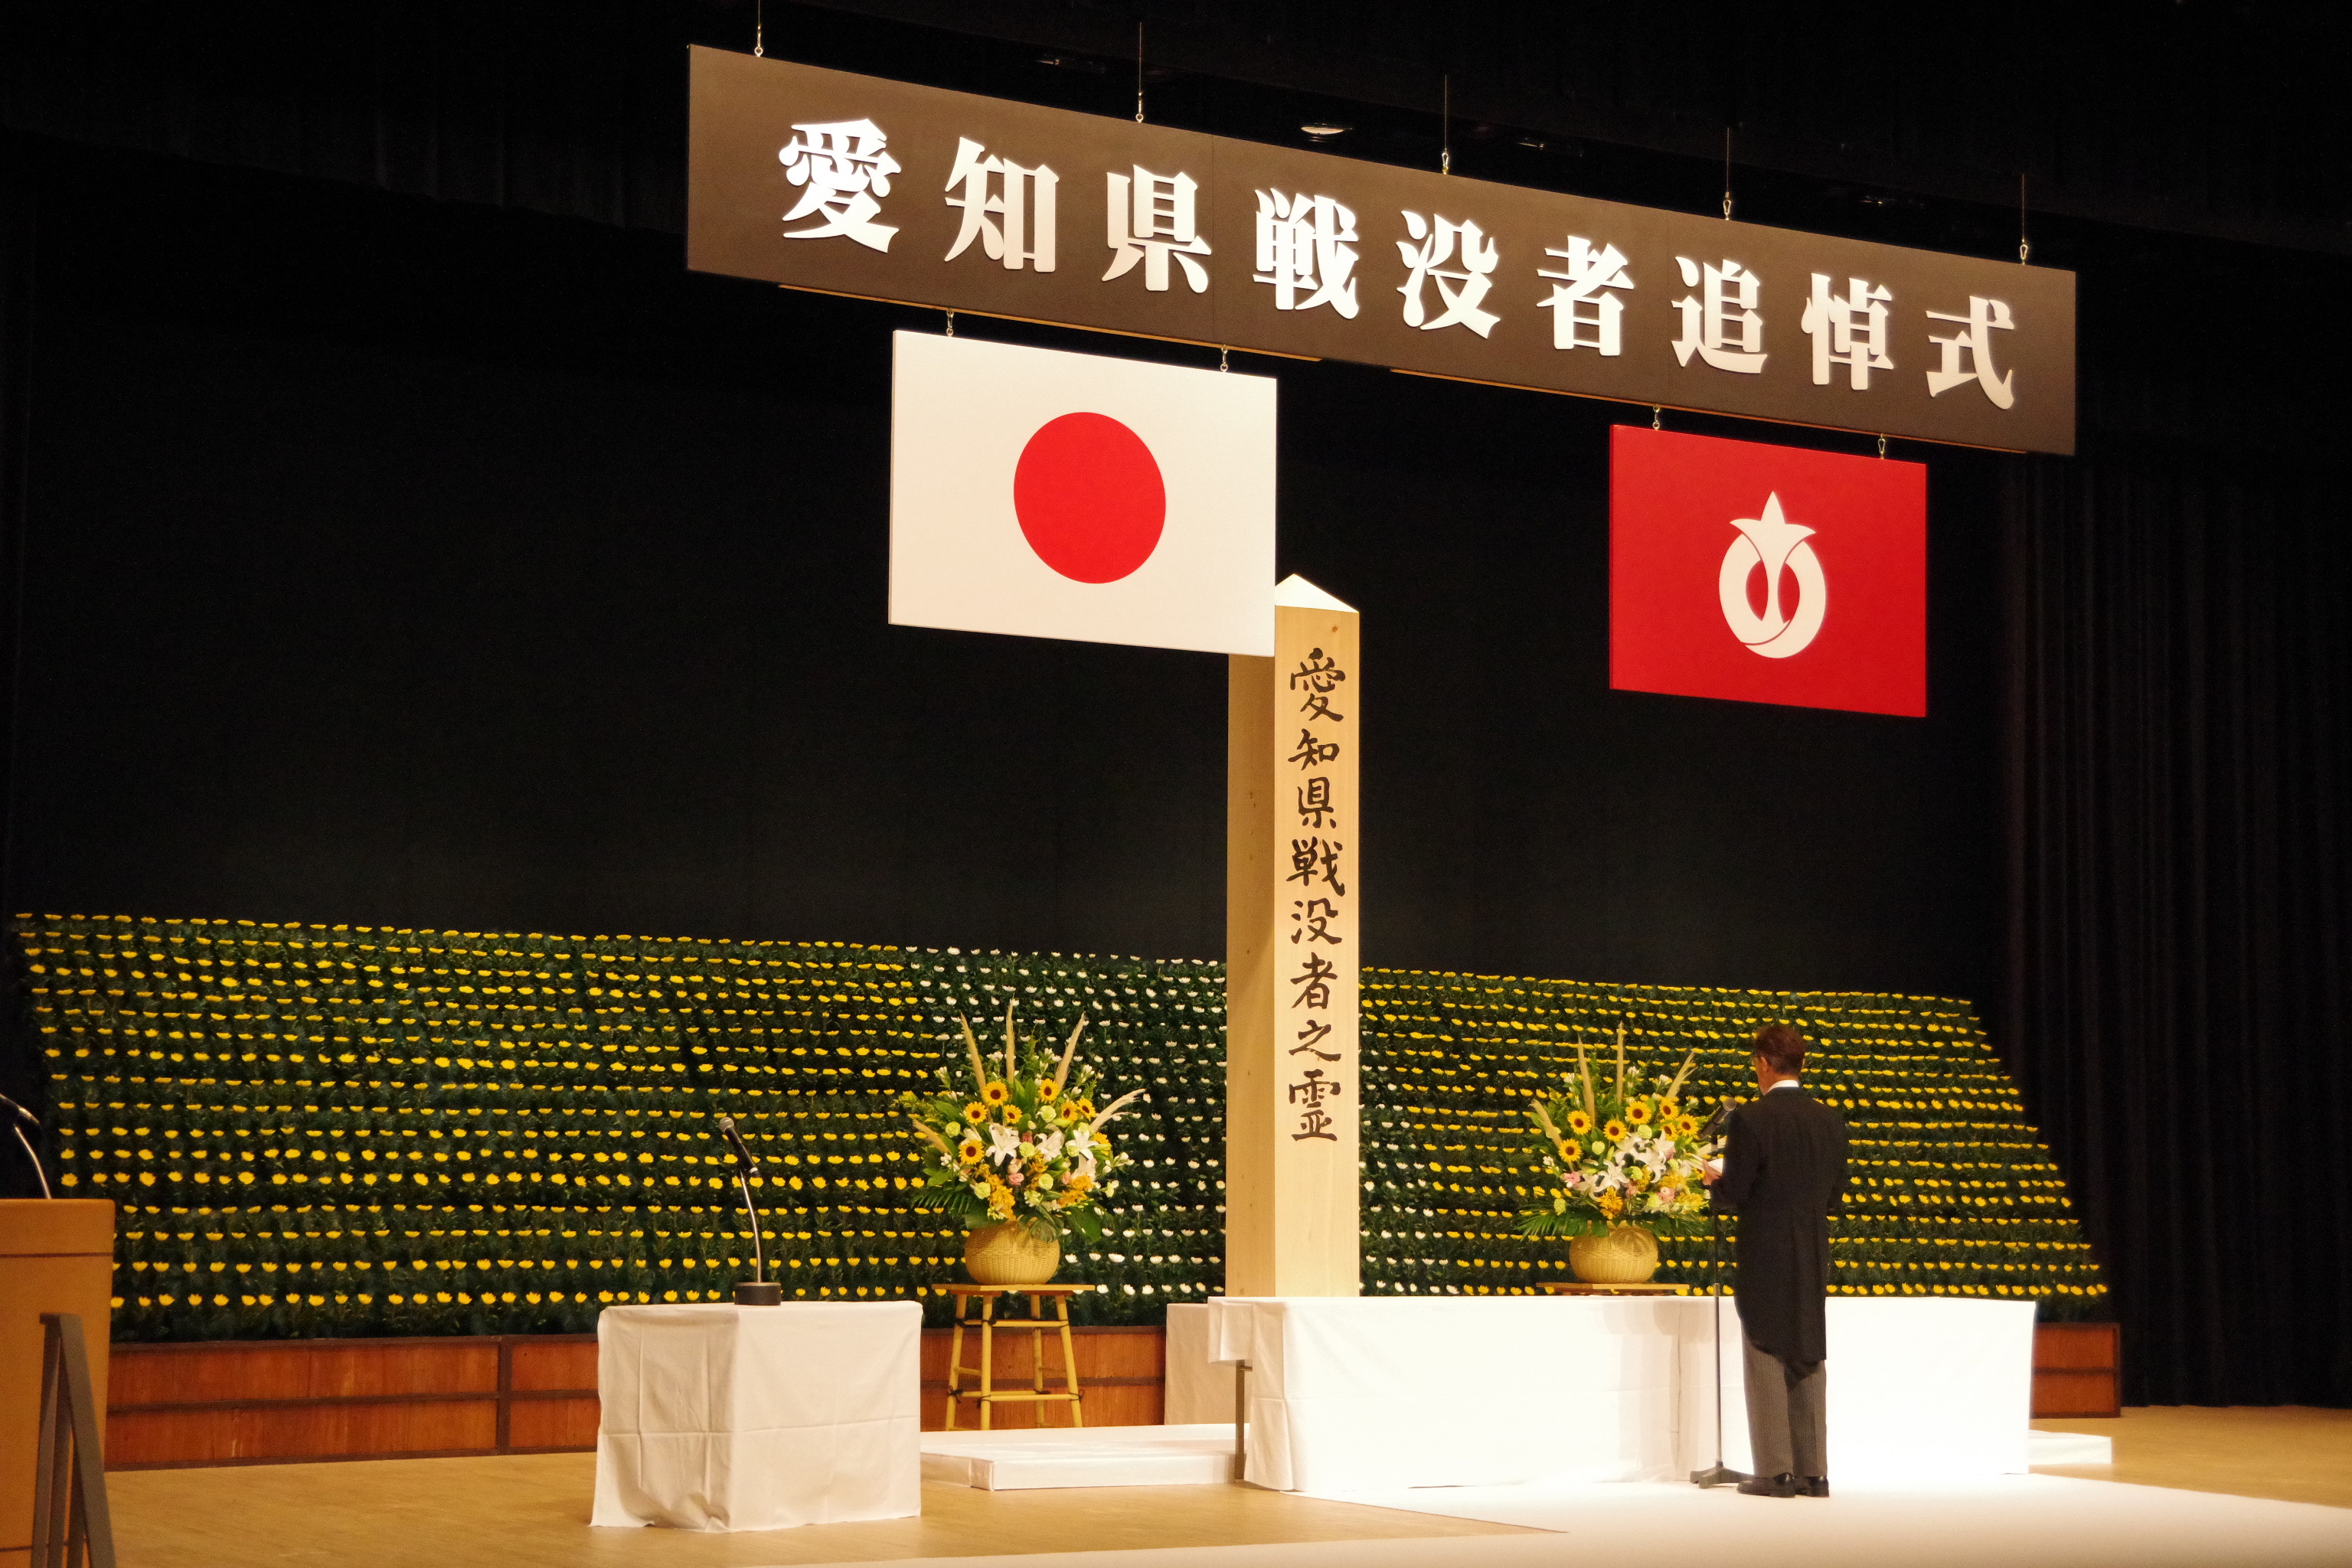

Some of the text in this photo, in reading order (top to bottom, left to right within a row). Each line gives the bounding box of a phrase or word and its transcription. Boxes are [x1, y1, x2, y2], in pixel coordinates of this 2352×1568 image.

[779, 118, 2014, 409] 愛知県戦没者追悼式
[1288, 647, 1346, 1142] 愛知県戦没者之霊
